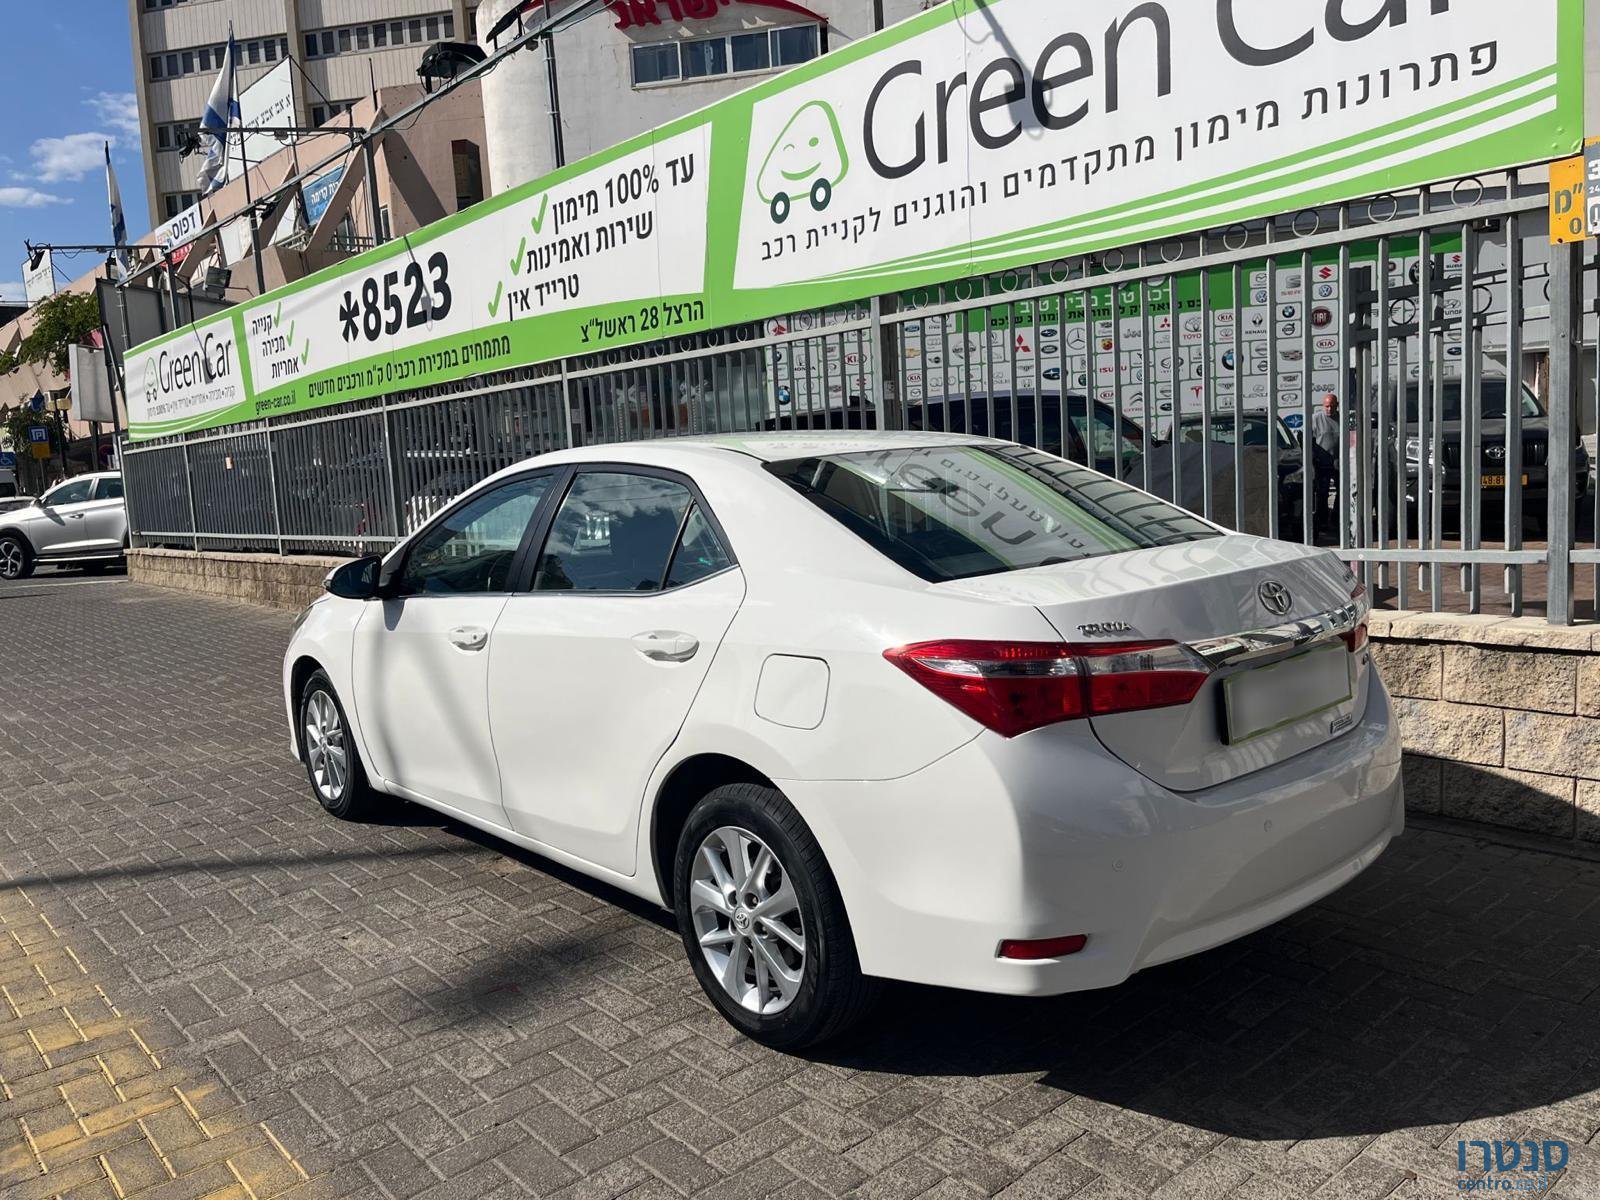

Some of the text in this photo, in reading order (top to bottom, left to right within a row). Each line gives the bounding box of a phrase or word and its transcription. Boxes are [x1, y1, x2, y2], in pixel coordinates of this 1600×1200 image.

[863, 2, 1172, 180] Green
[761, 40, 1498, 261] פתרונות מימון מתקדמים והוגנים לקניית רכב
[552, 153, 695, 235] עד 100% מימון
[172, 212, 196, 240] דפוס
[526, 210, 653, 275] שירות ואמינות
[507, 273, 579, 322] טרייד אין
[252, 314, 273, 336] קנייה
[580, 300, 704, 344] הרצל 28 ראשל"צ
[262, 335, 285, 357] מכירה
[461, 334, 511, 366] מתמחים
[159, 332, 231, 394] Green Car
[271, 356, 299, 379] אחריות
[386, 362, 394, 383] 0
[394, 357, 417, 381] רכבי
[418, 346, 460, 376] במכירת
[1099, 365, 1127, 373] ISUU
[308, 379, 335, 398] חדשים
[337, 371, 364, 392] ורכבים
[255, 389, 296, 415] green-car.co.il
